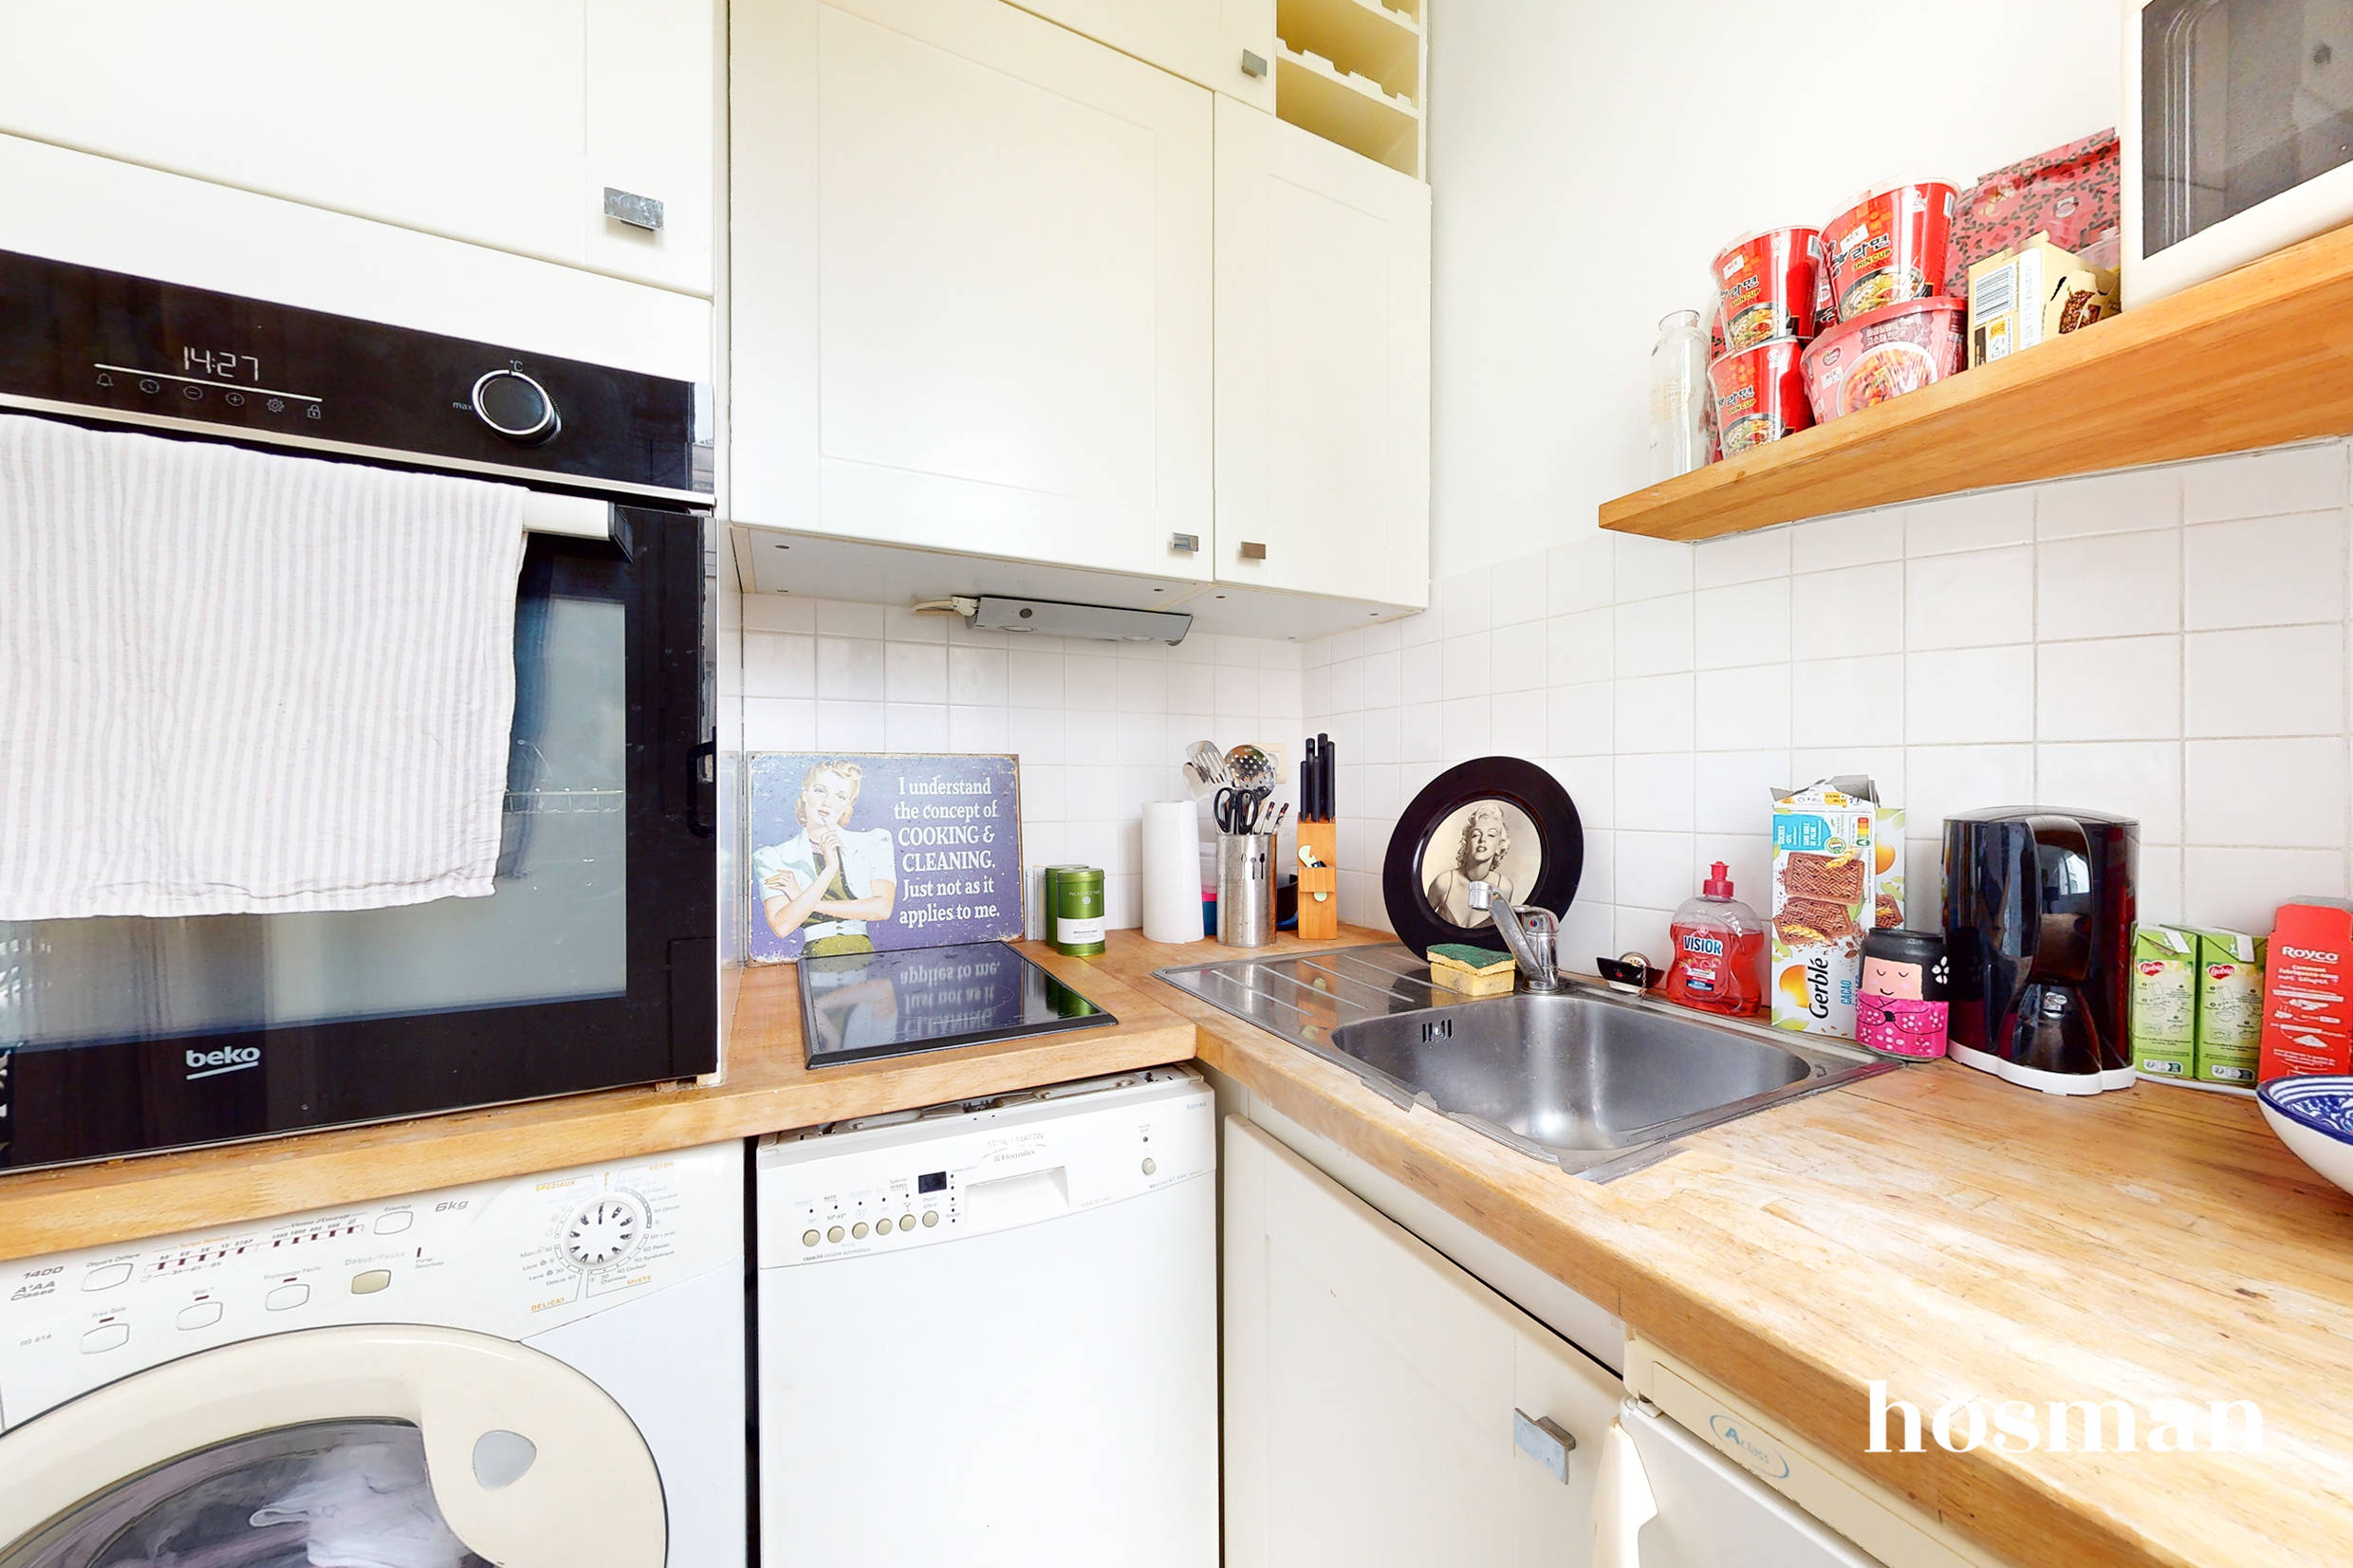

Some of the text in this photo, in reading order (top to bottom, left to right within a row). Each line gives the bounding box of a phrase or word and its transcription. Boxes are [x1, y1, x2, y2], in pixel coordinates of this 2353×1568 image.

[1852, 257, 1871, 270] SHIN
[1872, 249, 1892, 262] CUP
[1746, 288, 1762, 300] CUP
[183, 345, 259, 381] 14:27
[453, 401, 473, 411] max
[1741, 399, 1757, 409] CUP
[899, 776, 992, 795] I understand
[894, 799, 1001, 822] the concept of
[898, 825, 995, 846] COOKING &
[902, 850, 996, 873] CLEANING.
[903, 875, 994, 901] Just not as it
[899, 903, 1000, 929] applies to me.
[1684, 935, 1722, 954] VISIOR
[2282, 946, 2339, 963] Royco
[1807, 957, 1829, 1019] Gerblé
[1841, 980, 1852, 1005] CACAO
[186, 1046, 261, 1068] beko
[435, 1200, 469, 1212] 6kg
[24, 1266, 65, 1279] 1400
